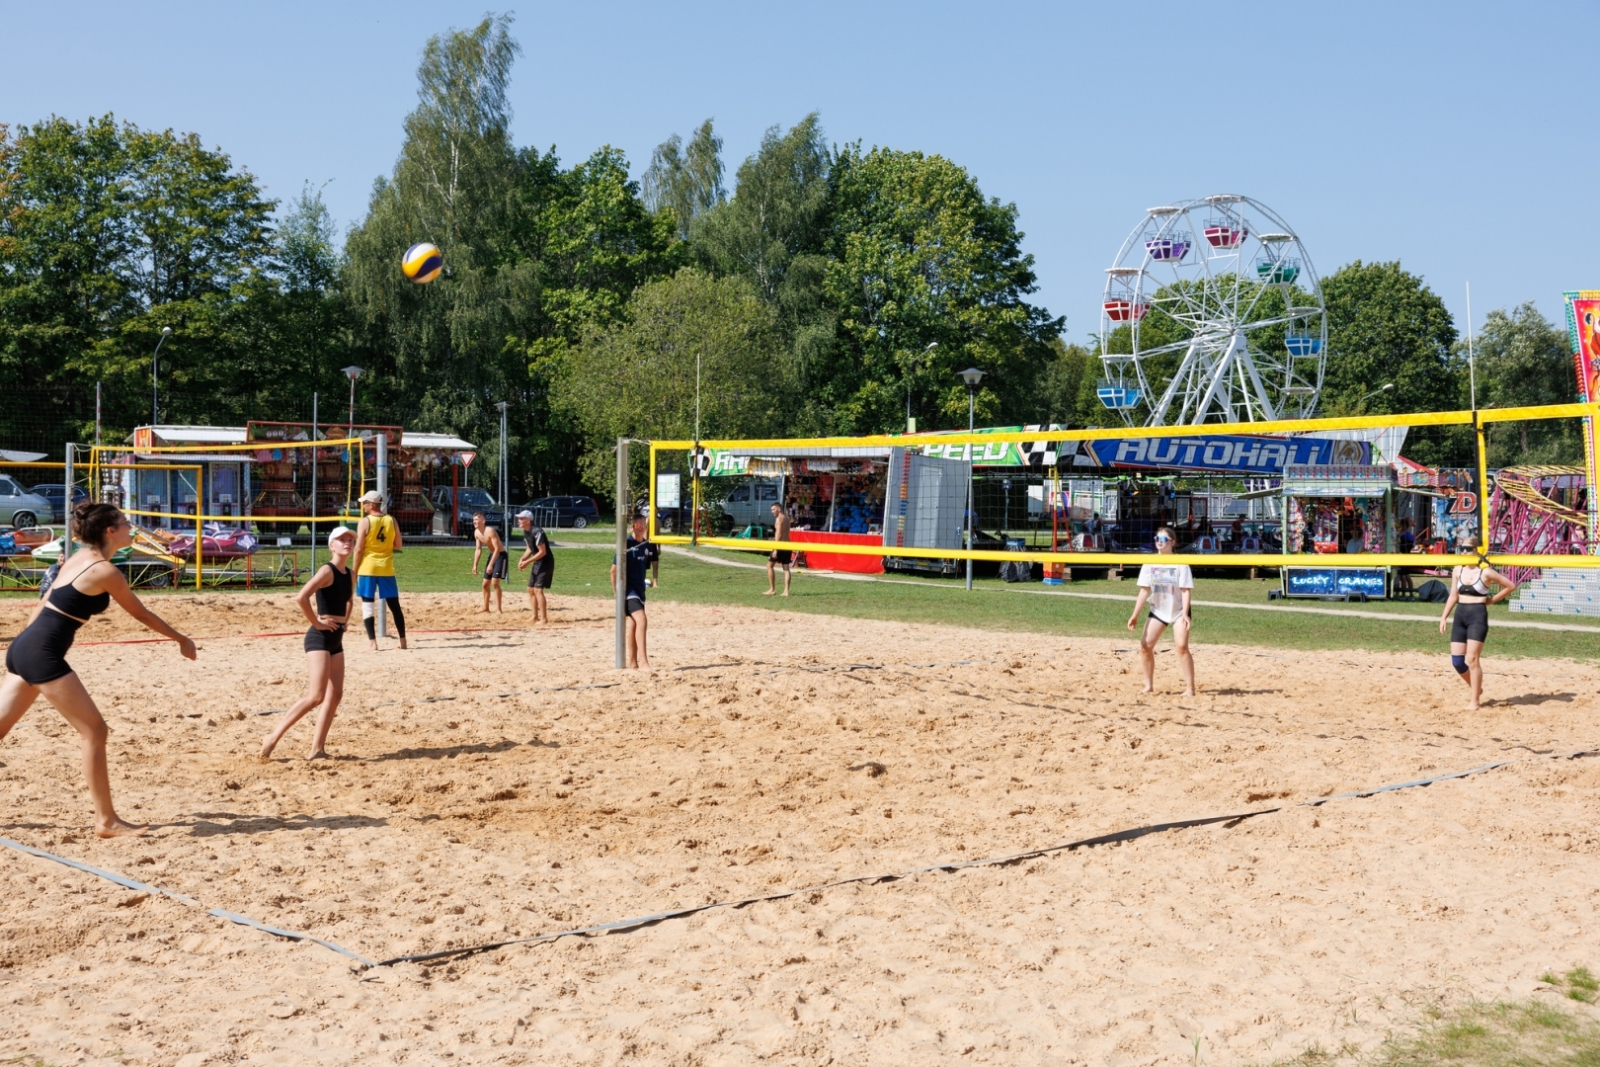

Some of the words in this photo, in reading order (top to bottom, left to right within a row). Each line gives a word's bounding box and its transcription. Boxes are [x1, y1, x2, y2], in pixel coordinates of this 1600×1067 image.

[922, 442, 1010, 461] PEED
[1450, 492, 1477, 513] 7D
[376, 526, 386, 543] 4
[1292, 576, 1330, 585] LUCKY
